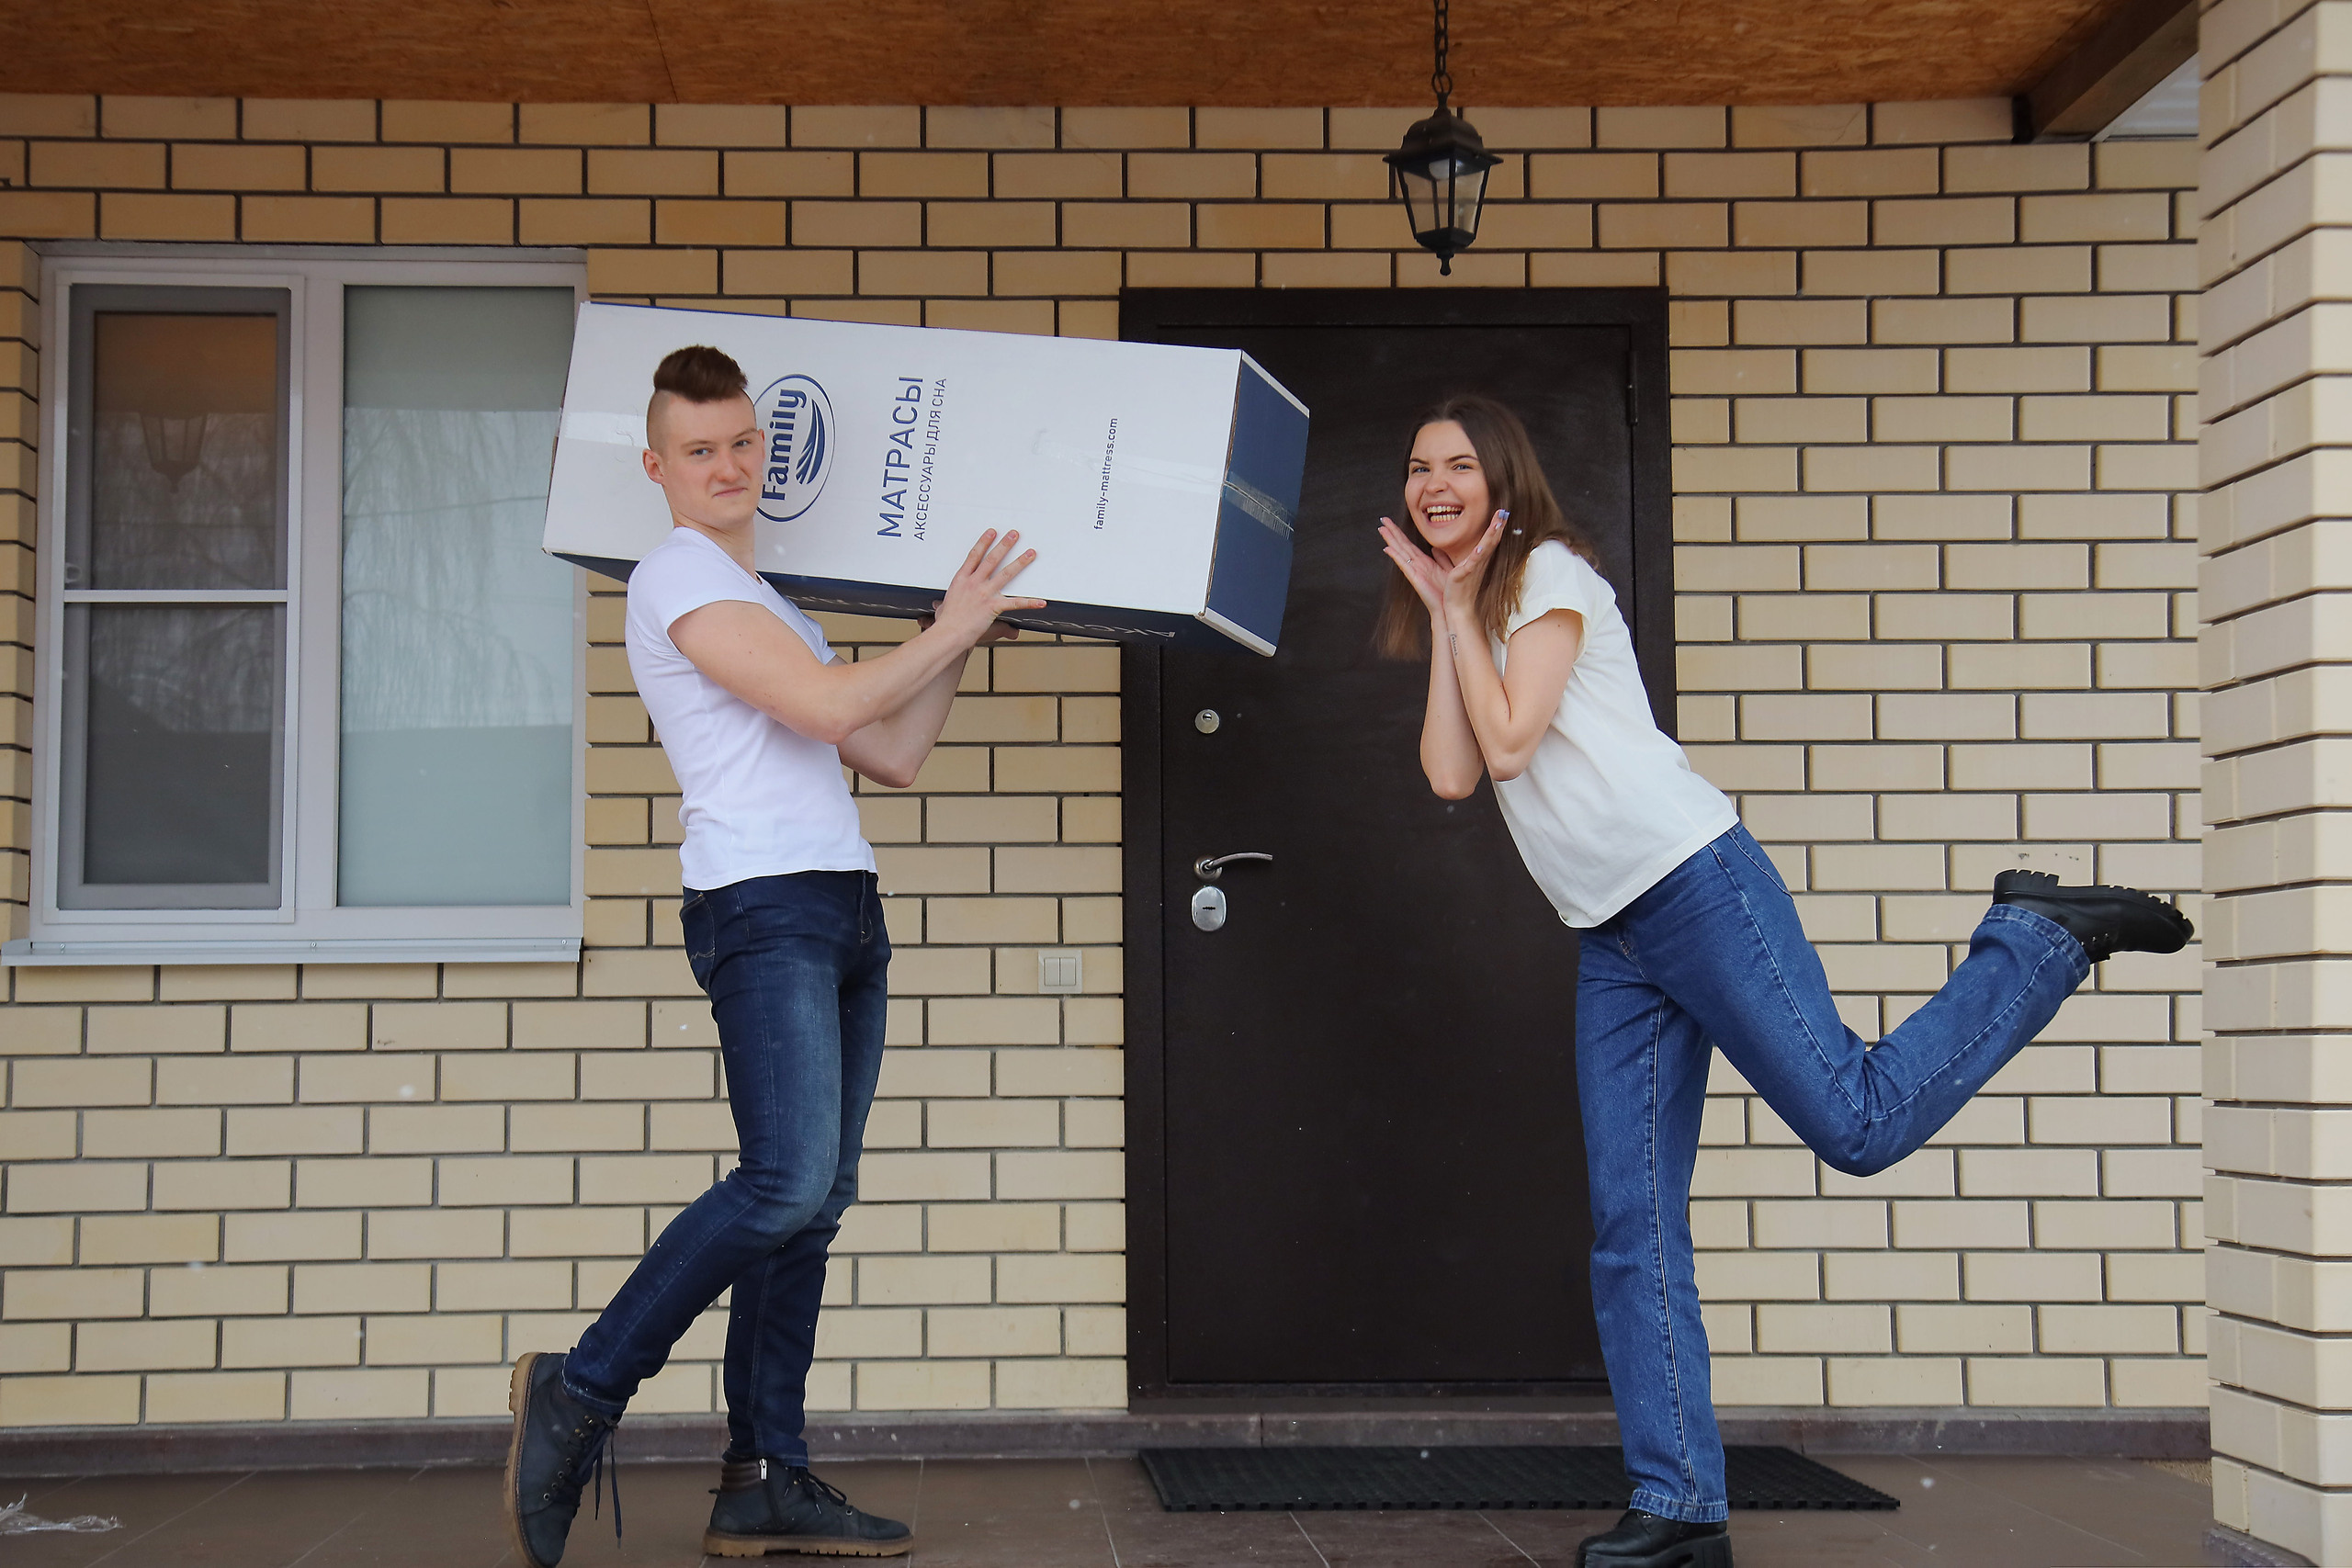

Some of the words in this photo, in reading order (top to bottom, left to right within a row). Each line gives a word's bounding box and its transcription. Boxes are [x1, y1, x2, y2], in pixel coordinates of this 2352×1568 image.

[926, 410, 942, 441] ДЛЯ
[932, 378, 947, 407] СНА
[762, 389, 808, 502] Family
[876, 376, 924, 538] МАТРАСЫ
[913, 444, 937, 541] АКСЕССУАРЫ
[1093, 418, 1118, 530] family-mattress.com
